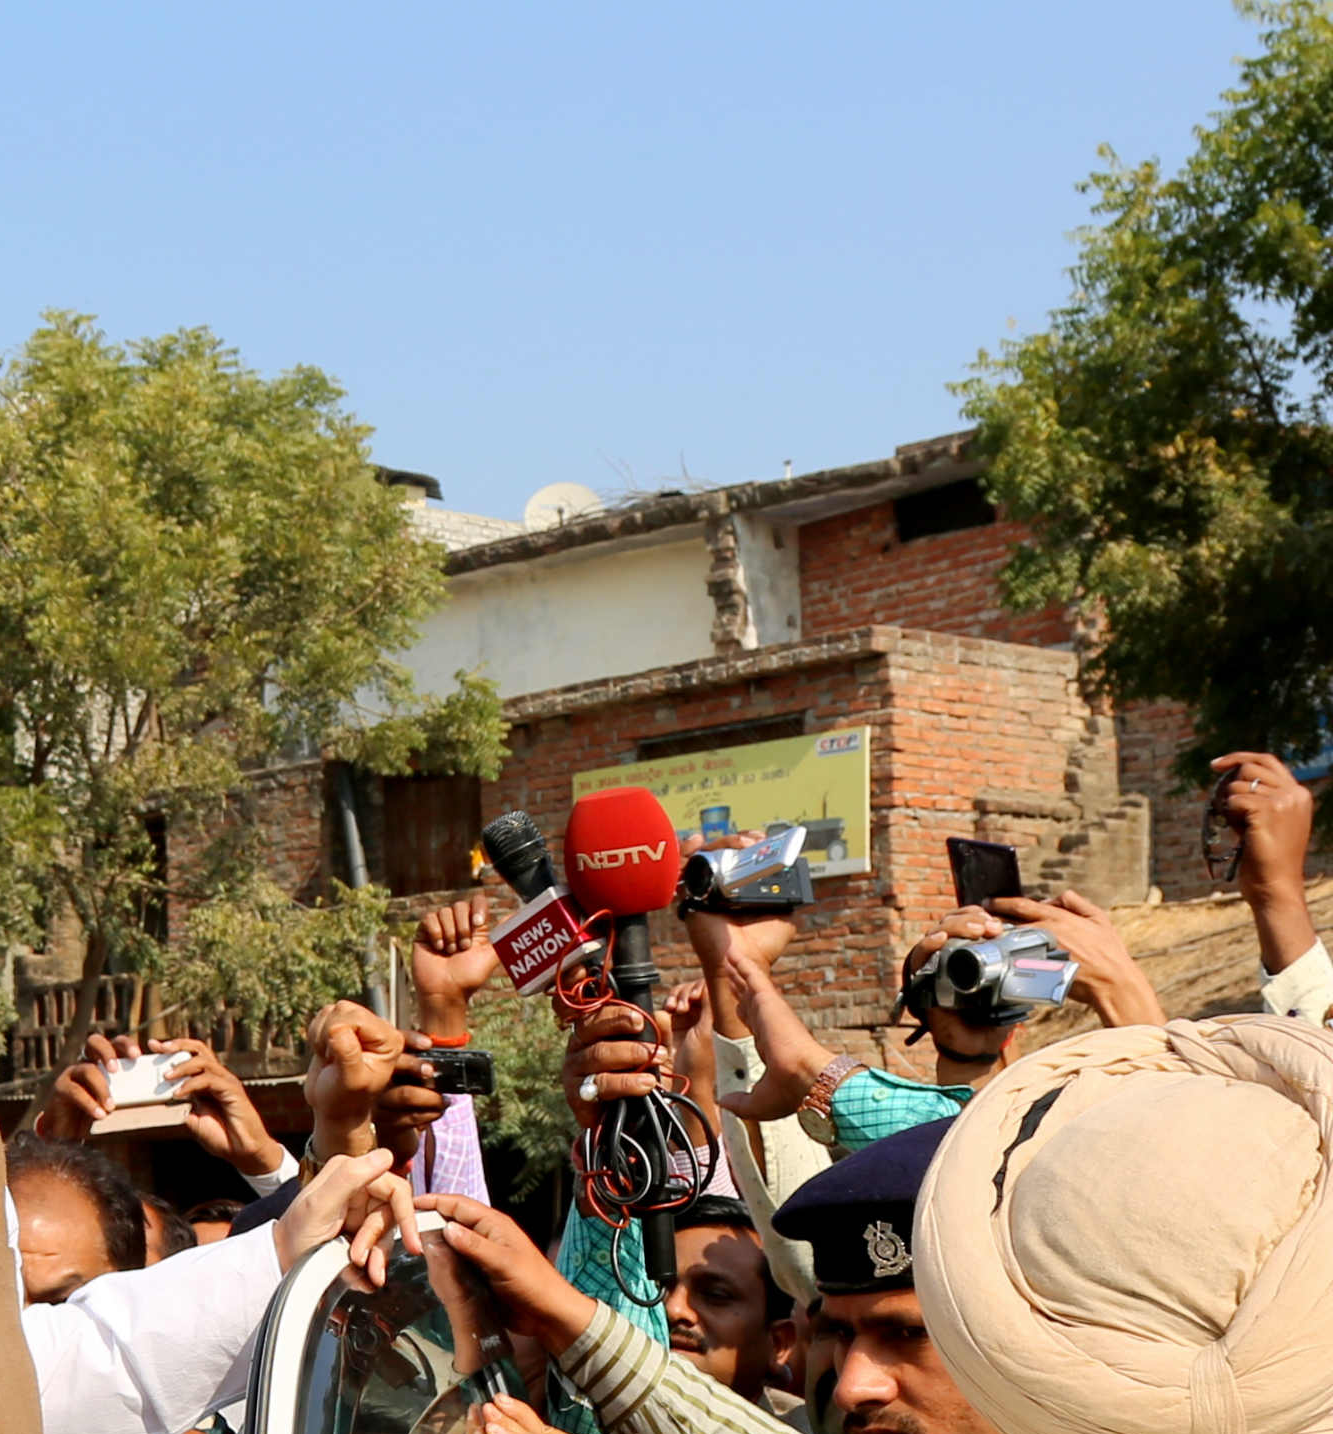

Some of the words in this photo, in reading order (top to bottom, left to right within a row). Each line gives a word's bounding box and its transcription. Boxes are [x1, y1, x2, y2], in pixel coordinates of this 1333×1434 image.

[576, 841, 666, 871] NDTV
[510, 928, 571, 978] NATION
[511, 918, 553, 954] NEWS
